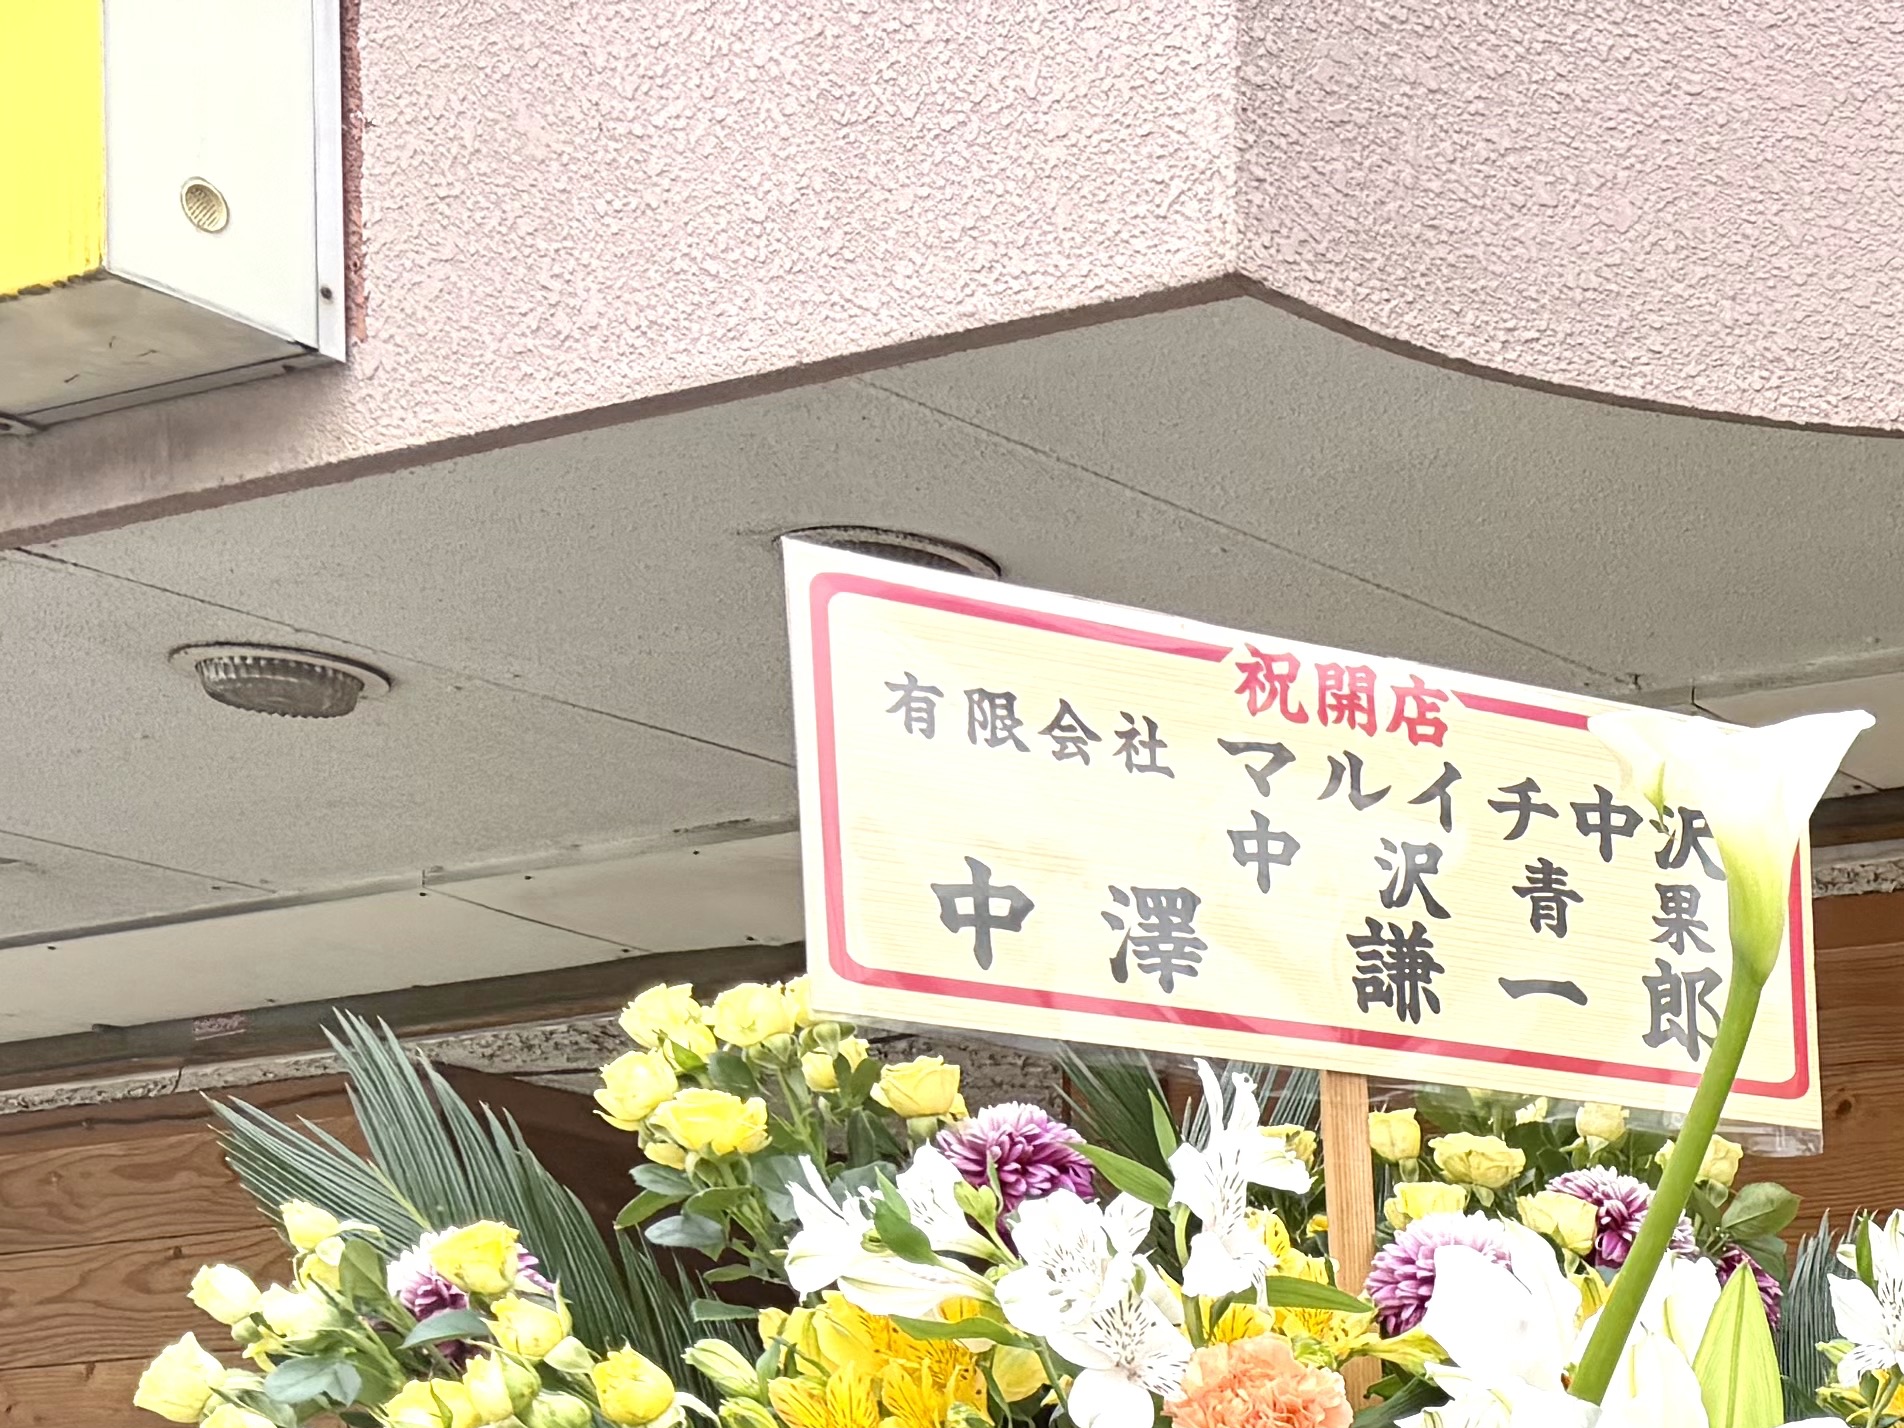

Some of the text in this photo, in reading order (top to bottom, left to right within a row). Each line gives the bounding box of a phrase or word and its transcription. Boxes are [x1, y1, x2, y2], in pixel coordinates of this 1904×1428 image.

[883, 670, 1177, 780] 有限会社
[1232, 642, 1458, 749] 祝開店
[1225, 810, 1716, 956] 中沢青果
[929, 853, 1724, 1062] 中澤謙一郎
